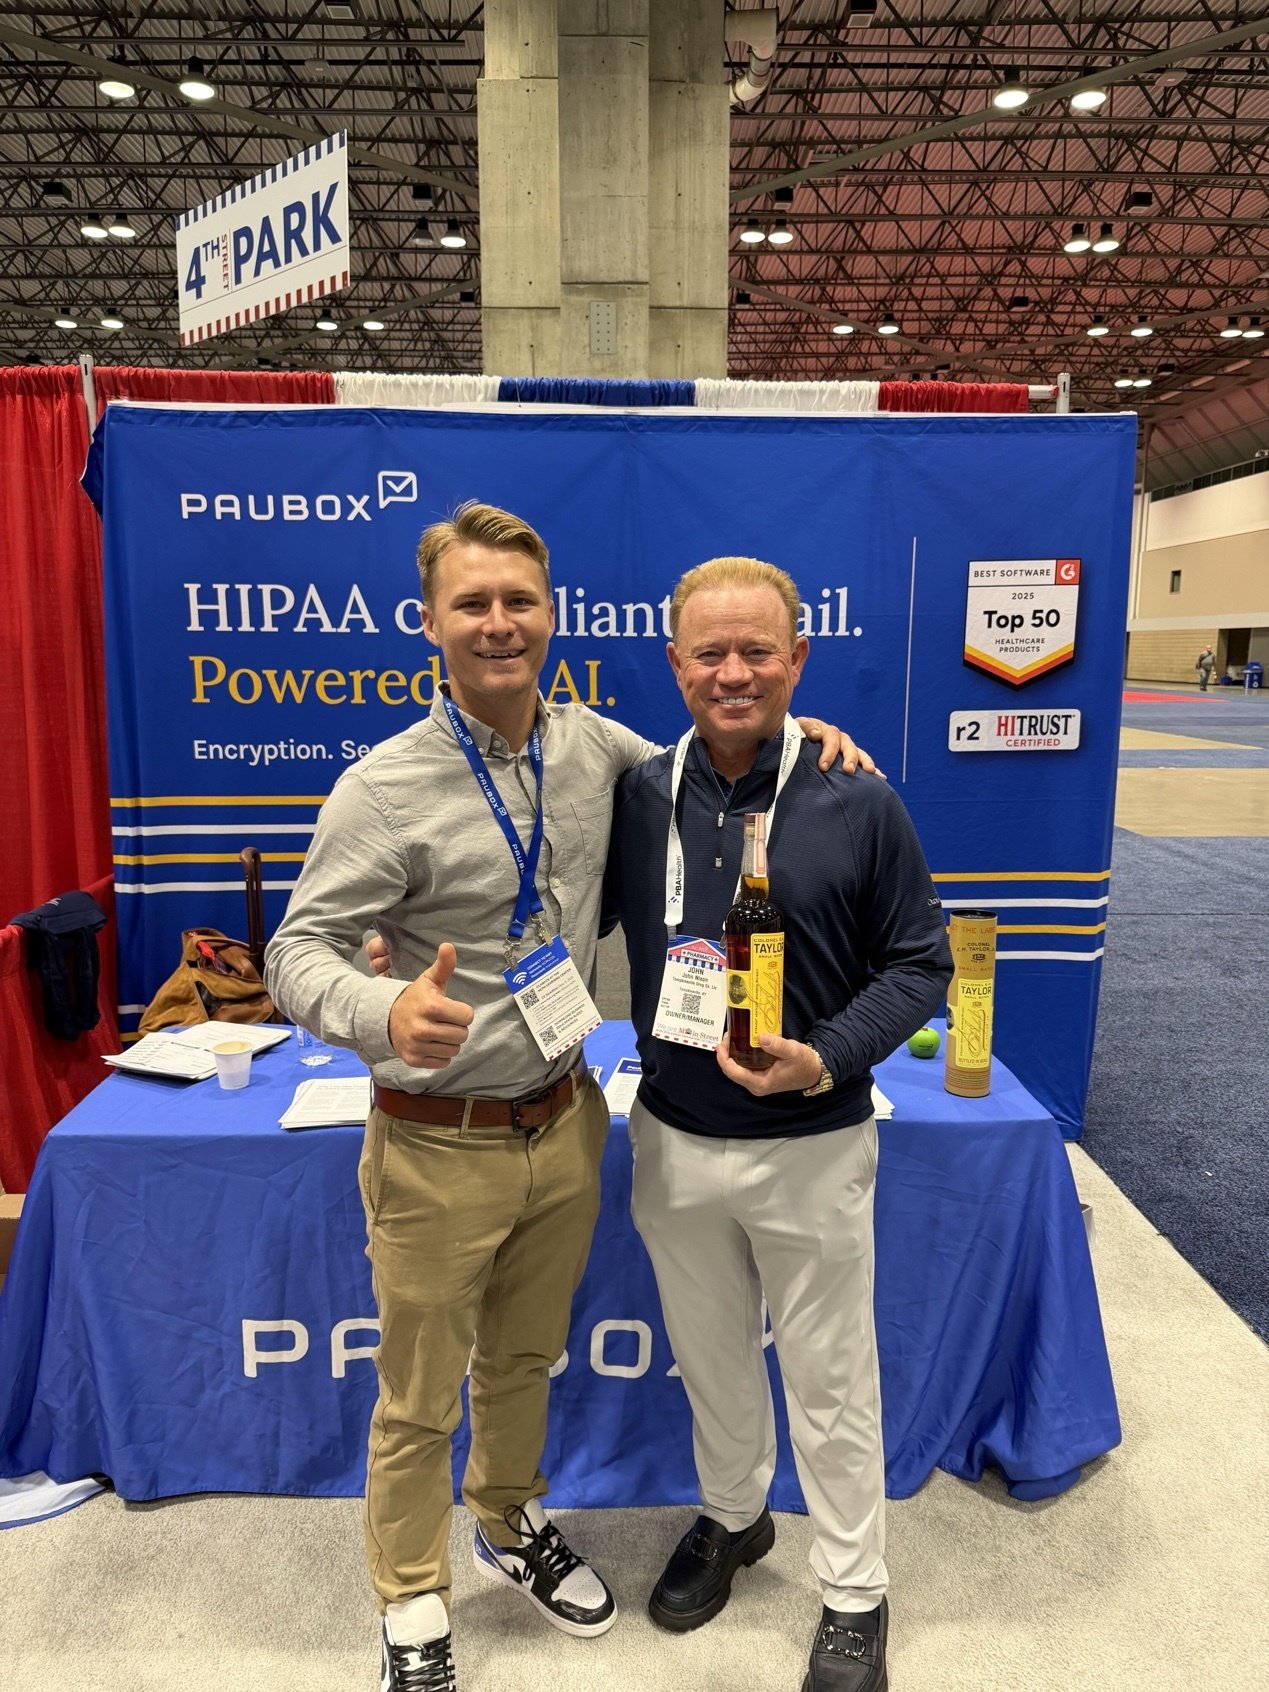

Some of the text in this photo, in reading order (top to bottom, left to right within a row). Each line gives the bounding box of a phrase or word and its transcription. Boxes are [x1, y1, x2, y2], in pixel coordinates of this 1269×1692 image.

[185, 181, 343, 300] 4TH STREET PARK
[181, 493, 372, 521] PAUBOX
[974, 568, 1051, 578] BEST SOFTWARE
[1011, 592, 1035, 600] 2025
[184, 583, 863, 637] HIPAA cliant ail.
[983, 609, 1061, 633] Top 50
[995, 637, 1045, 645] HEALTHCARE
[189, 654, 616, 707] Powered AI.
[446, 702, 465, 739] PAUBOX
[956, 721, 981, 742] r2
[996, 714, 1073, 737] HITRUST
[193, 738, 334, 766] Encryption.
[1005, 738, 1061, 748] CERTIFIED
[478, 772, 499, 809] PAUBOX
[687, 951, 715, 961] PHARMACY
[688, 966, 705, 976] JOHN
[960, 985, 992, 996] TAYLOR
[665, 1009, 715, 1026] OWNER/MANAGER
